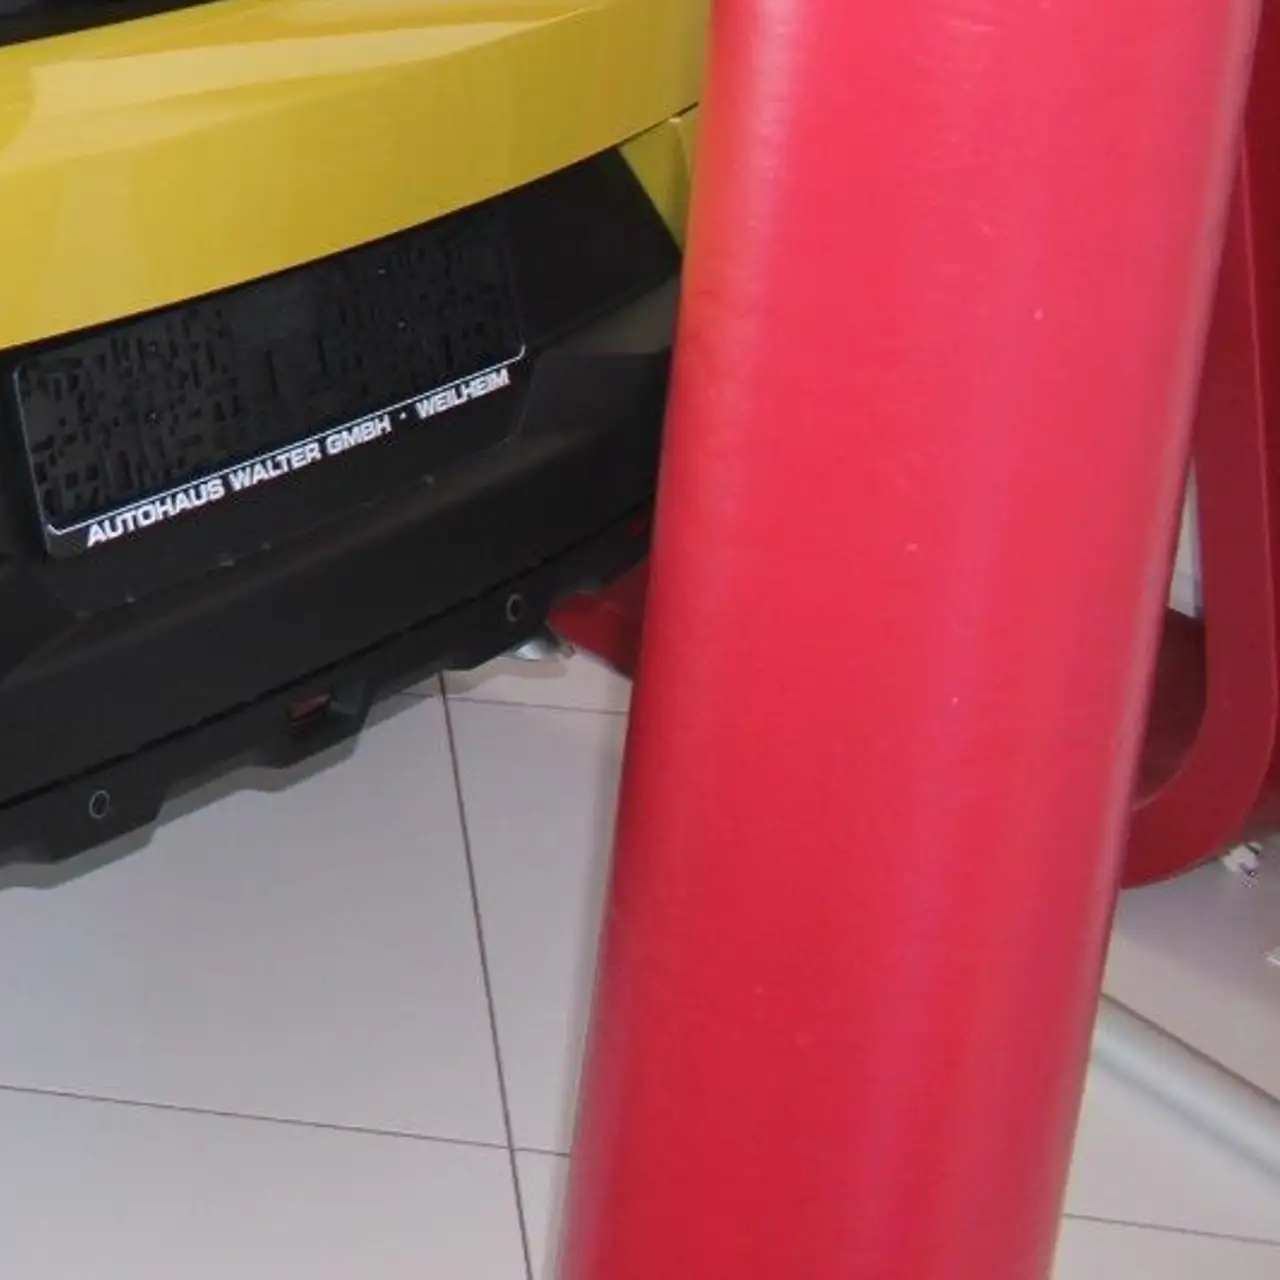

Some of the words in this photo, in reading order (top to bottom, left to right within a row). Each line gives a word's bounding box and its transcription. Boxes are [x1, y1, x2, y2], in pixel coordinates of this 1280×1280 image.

[86, 477, 226, 548] AUTOHAUS
[228, 441, 323, 493] WALTER
[324, 414, 393, 456] GMBH
[414, 366, 512, 420] WEILHEIM
